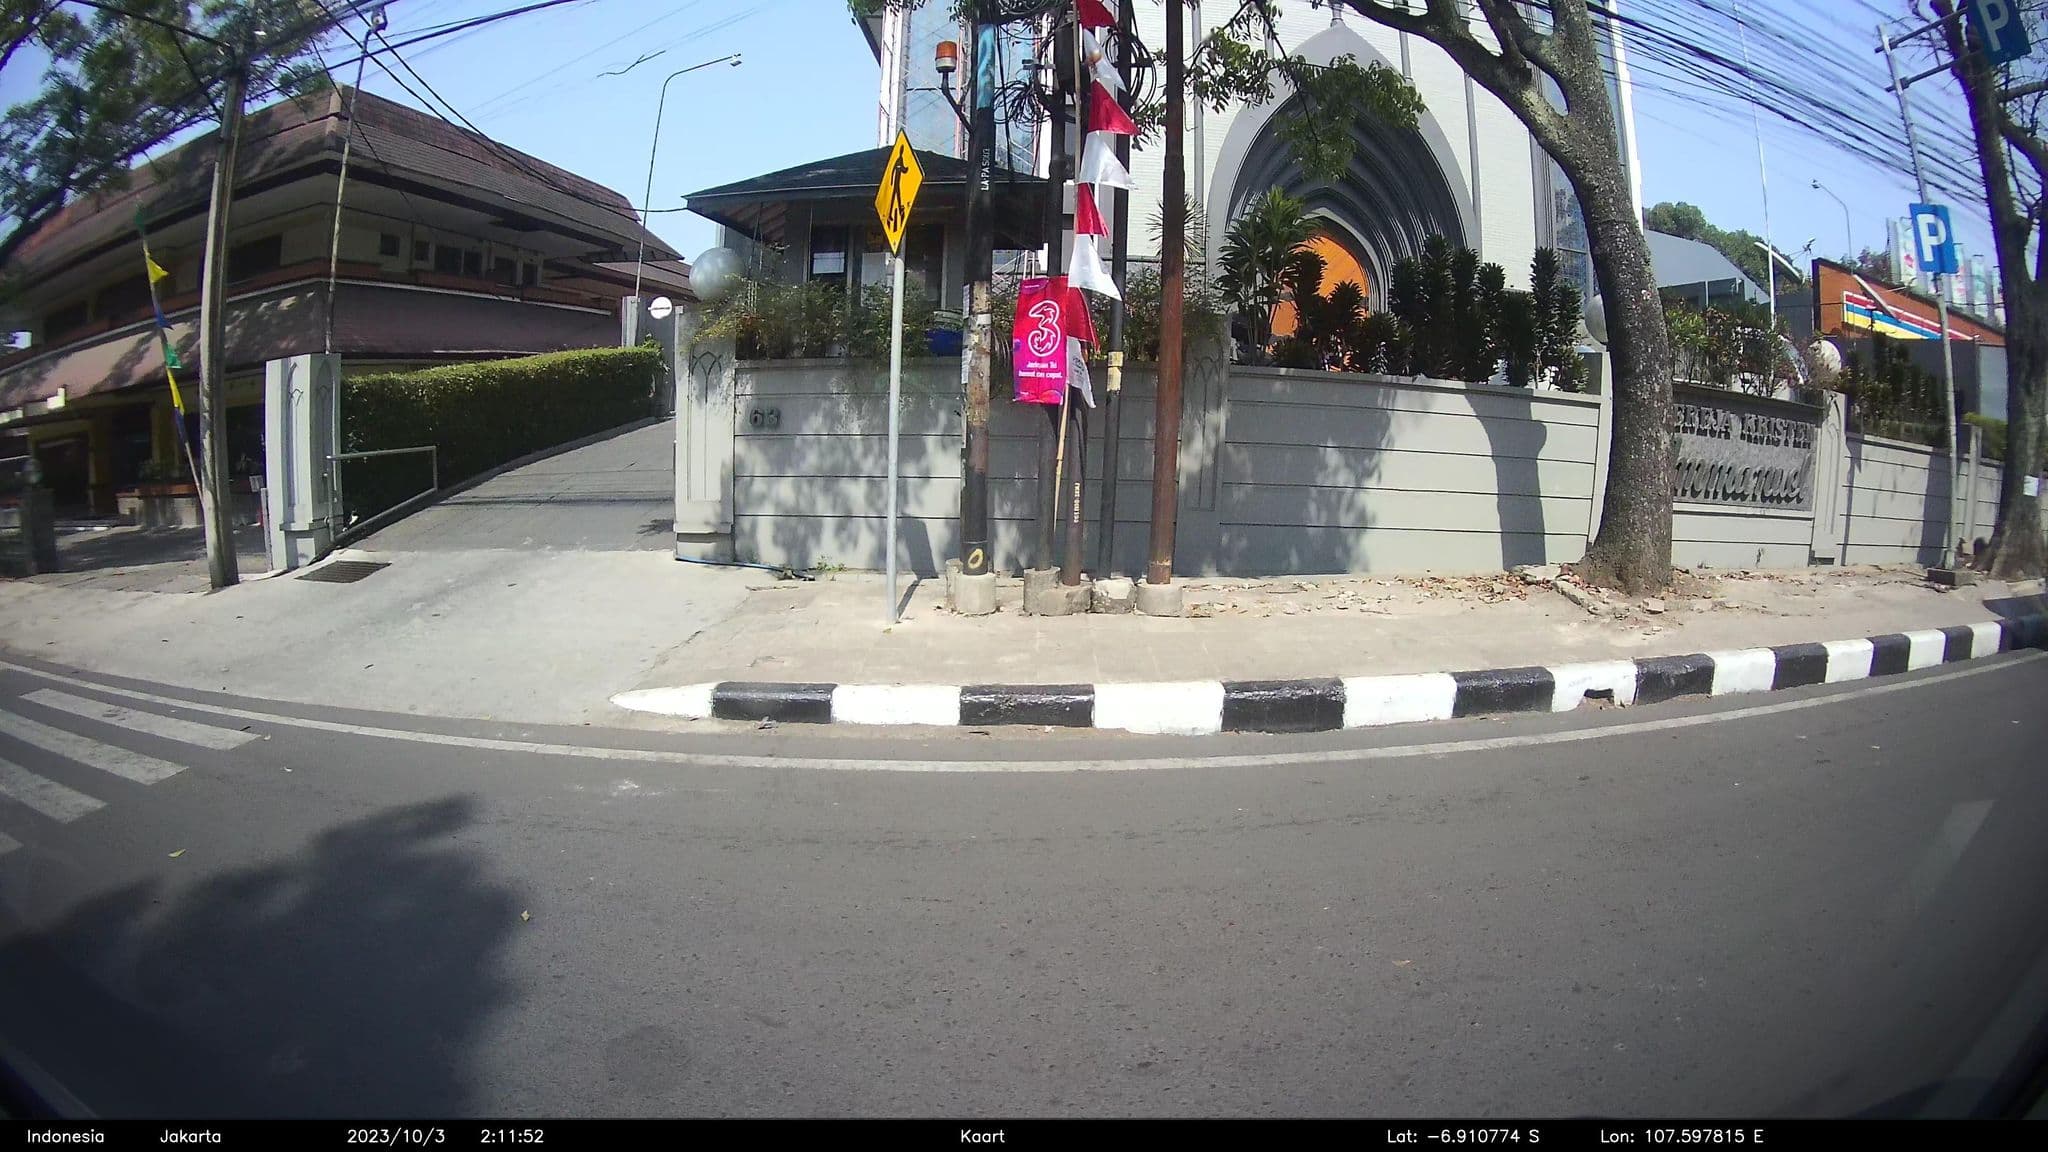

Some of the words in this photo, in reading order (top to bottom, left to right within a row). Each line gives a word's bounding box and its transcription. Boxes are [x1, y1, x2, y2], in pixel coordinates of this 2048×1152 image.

[1976, 0, 2010, 52] P
[1916, 213, 1947, 262] P
[1028, 300, 1061, 357] 3
[1673, 404, 1732, 436] EREJA
[1741, 413, 1817, 445] KRISTEN
[1674, 453, 1814, 502] mmanuel
